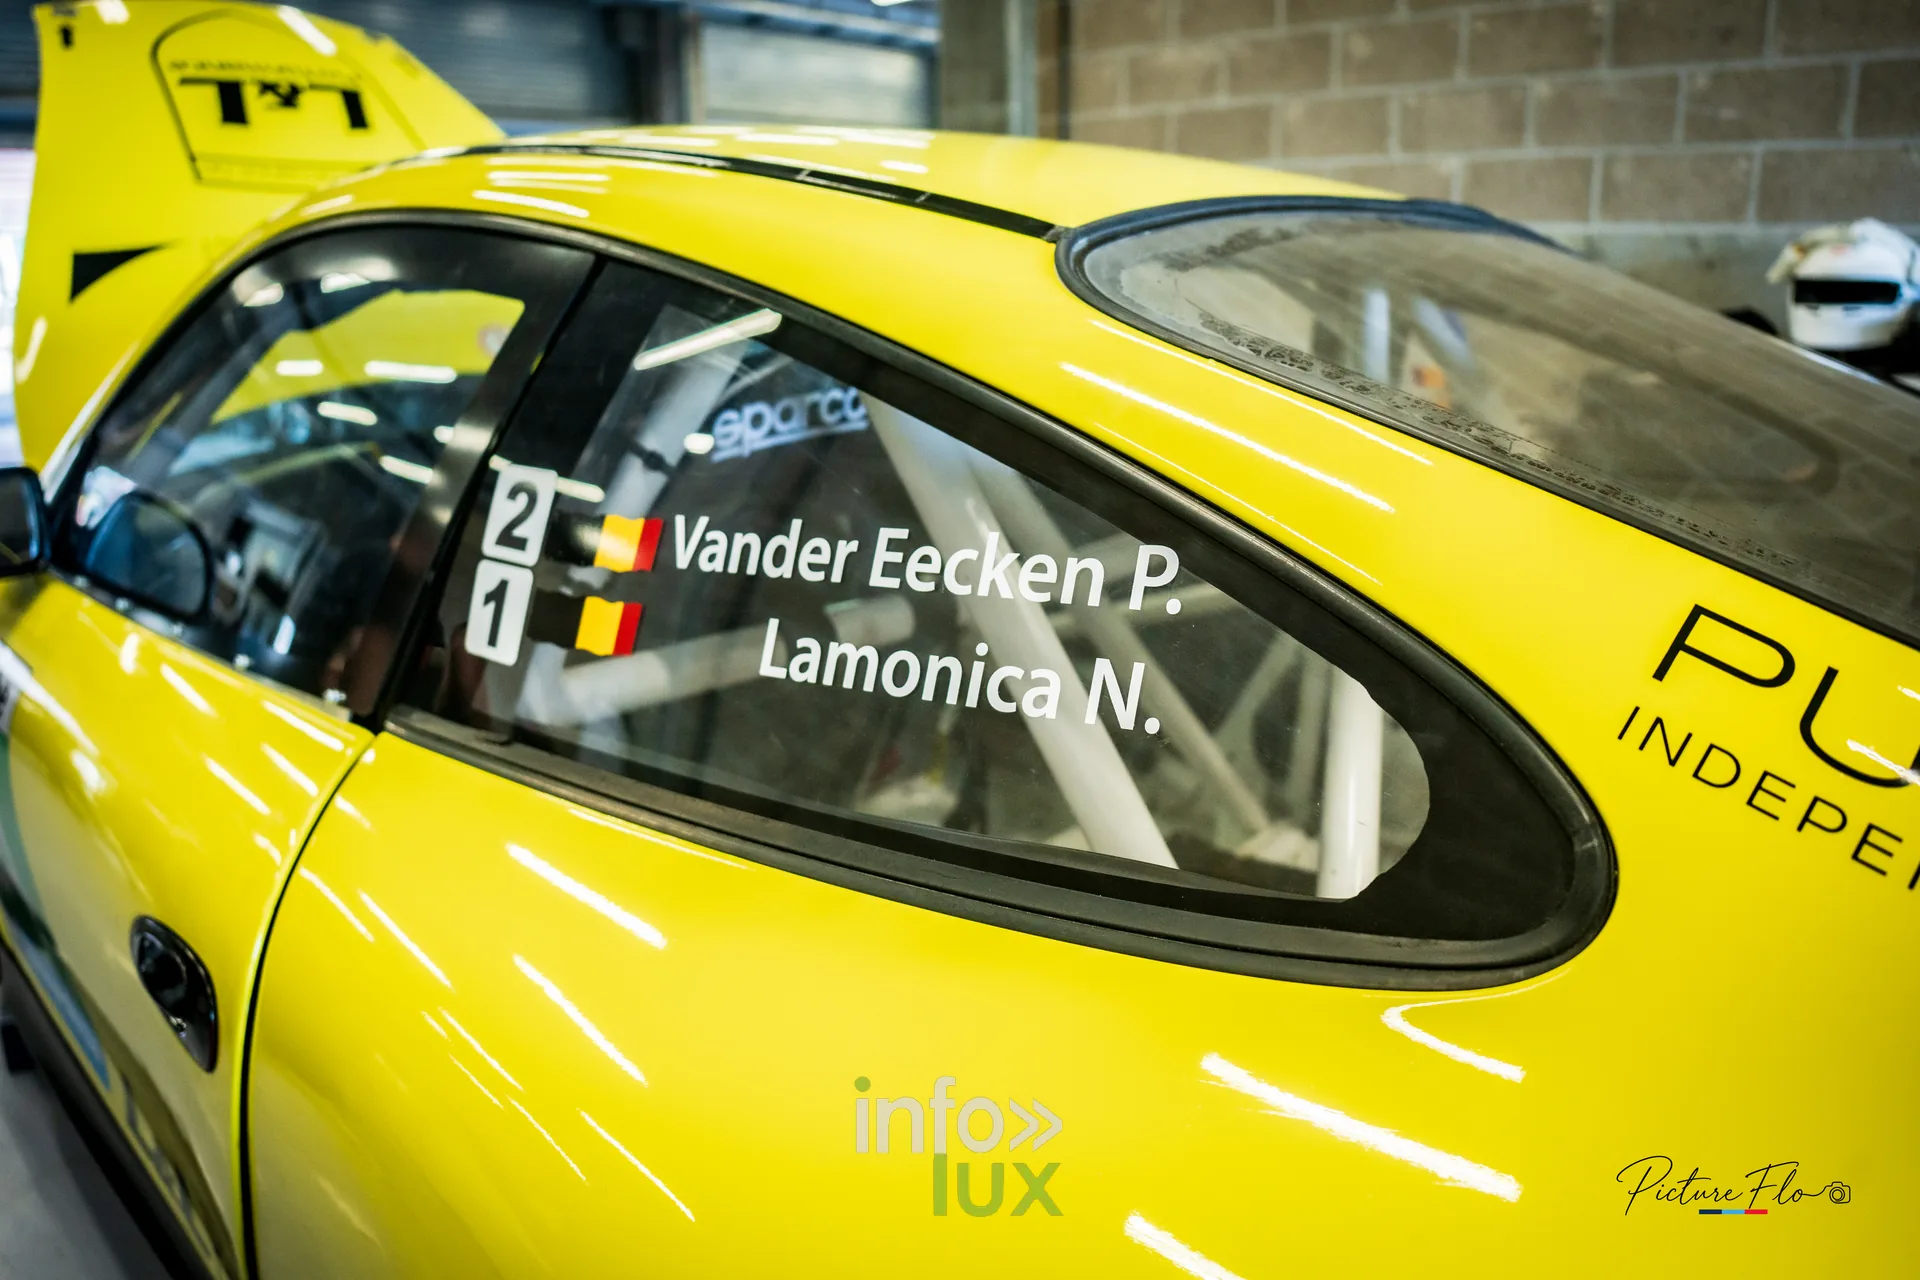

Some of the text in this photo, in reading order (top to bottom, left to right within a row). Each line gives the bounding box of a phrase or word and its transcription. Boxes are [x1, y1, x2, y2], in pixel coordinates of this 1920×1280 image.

[495, 481, 538, 551] 2
[674, 515, 1183, 615] Vander Eecken P.
[483, 578, 509, 648] 1
[759, 617, 1162, 735] Lamonica N.
[1617, 706, 1920, 891] INDEPE
